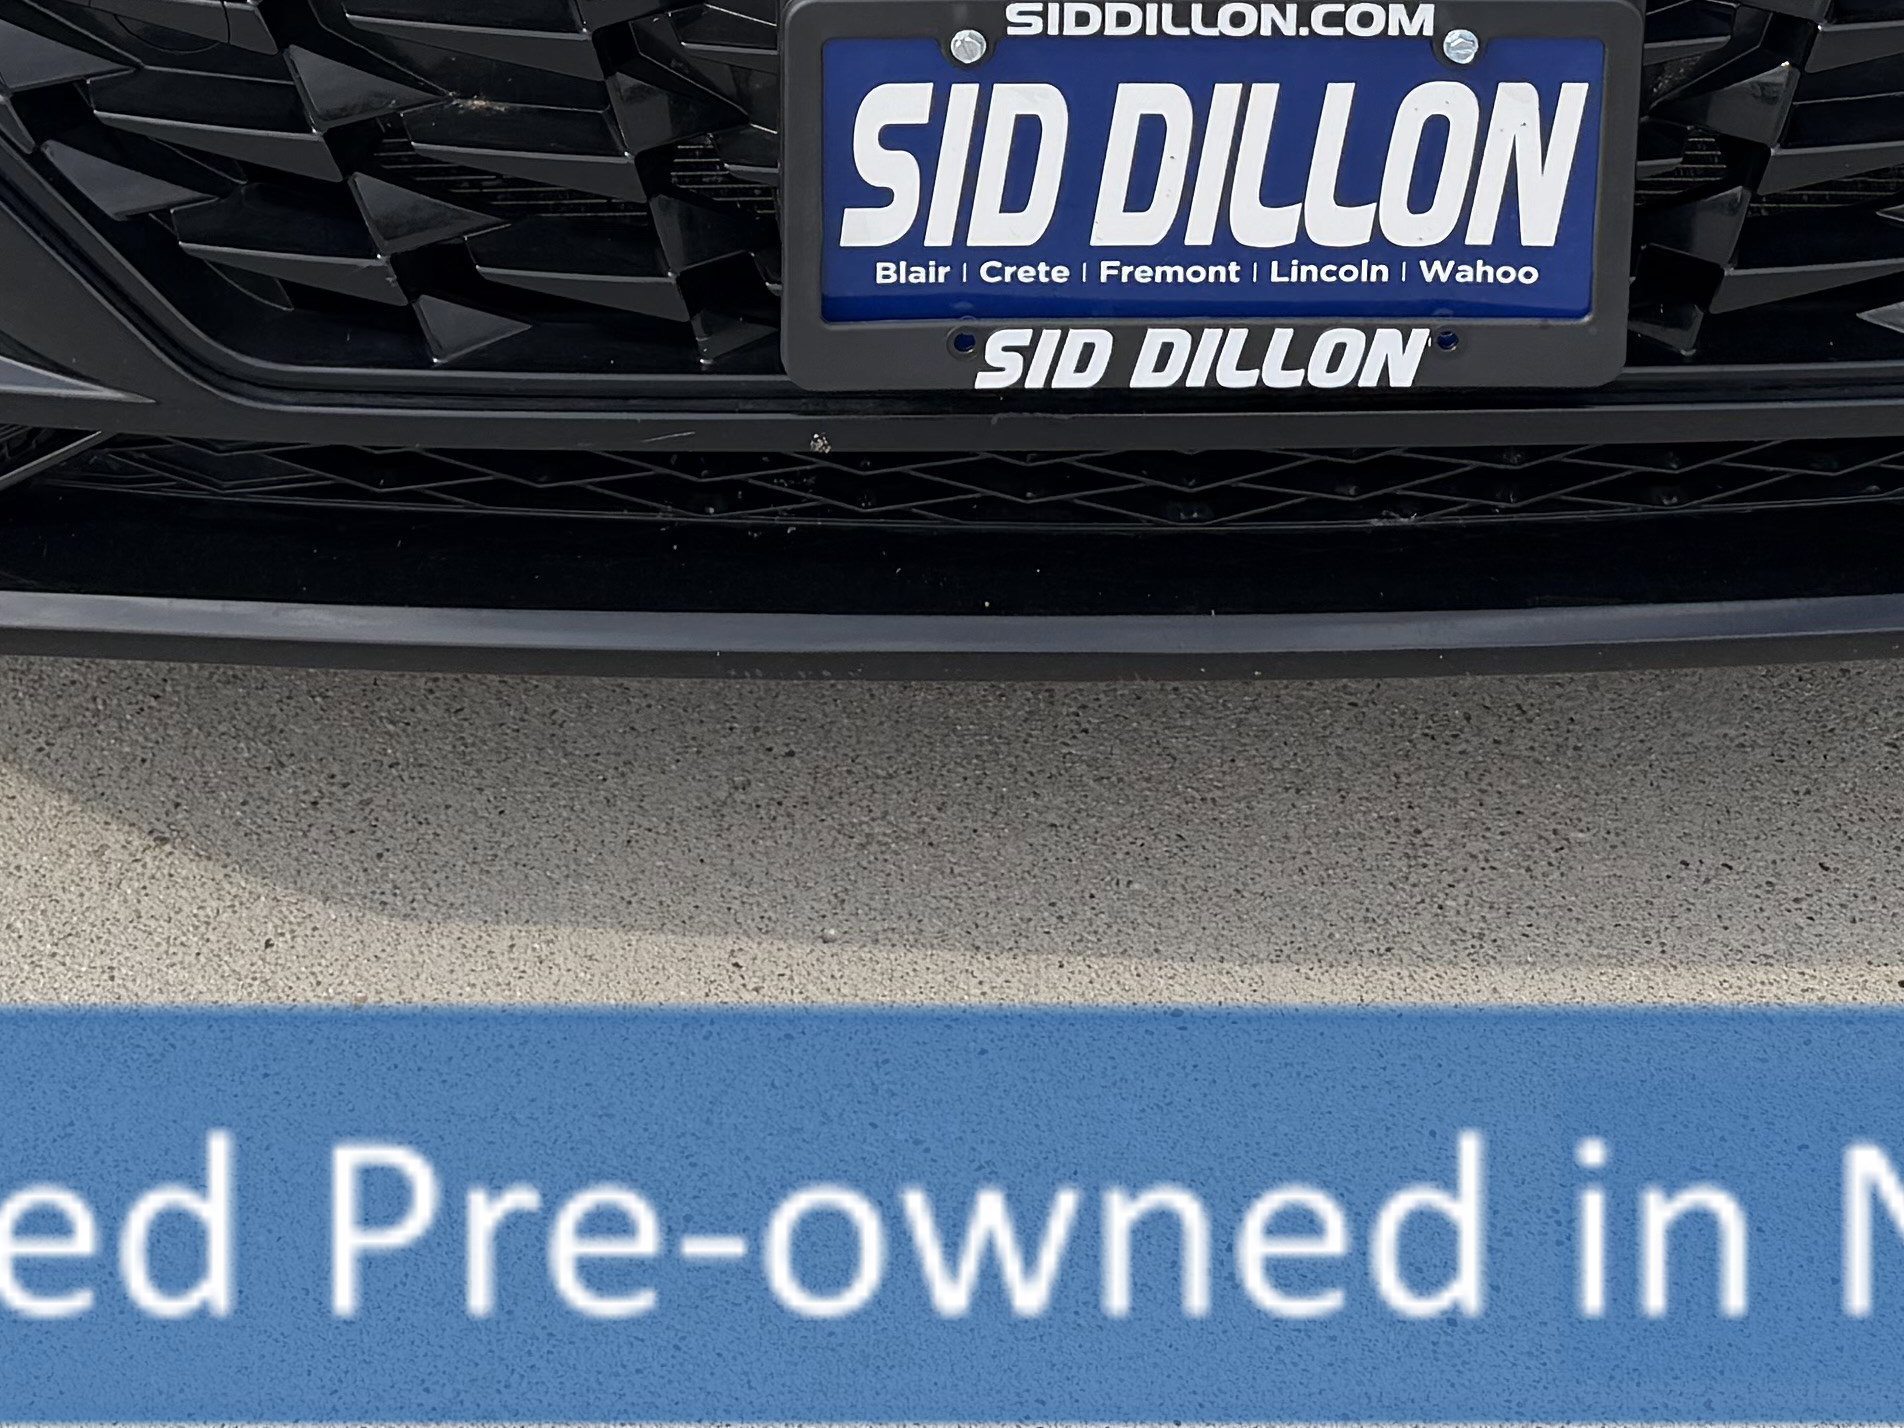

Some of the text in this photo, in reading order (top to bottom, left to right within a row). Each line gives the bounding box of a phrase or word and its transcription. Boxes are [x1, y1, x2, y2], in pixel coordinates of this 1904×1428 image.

[1005, 1, 1436, 39] SIDDILLON.COM
[839, 80, 1589, 249] SID DILLON
[875, 258, 1539, 286] Blair Crete Fremont Lincoln Wahoo
[974, 327, 1429, 390] SID DILLON
